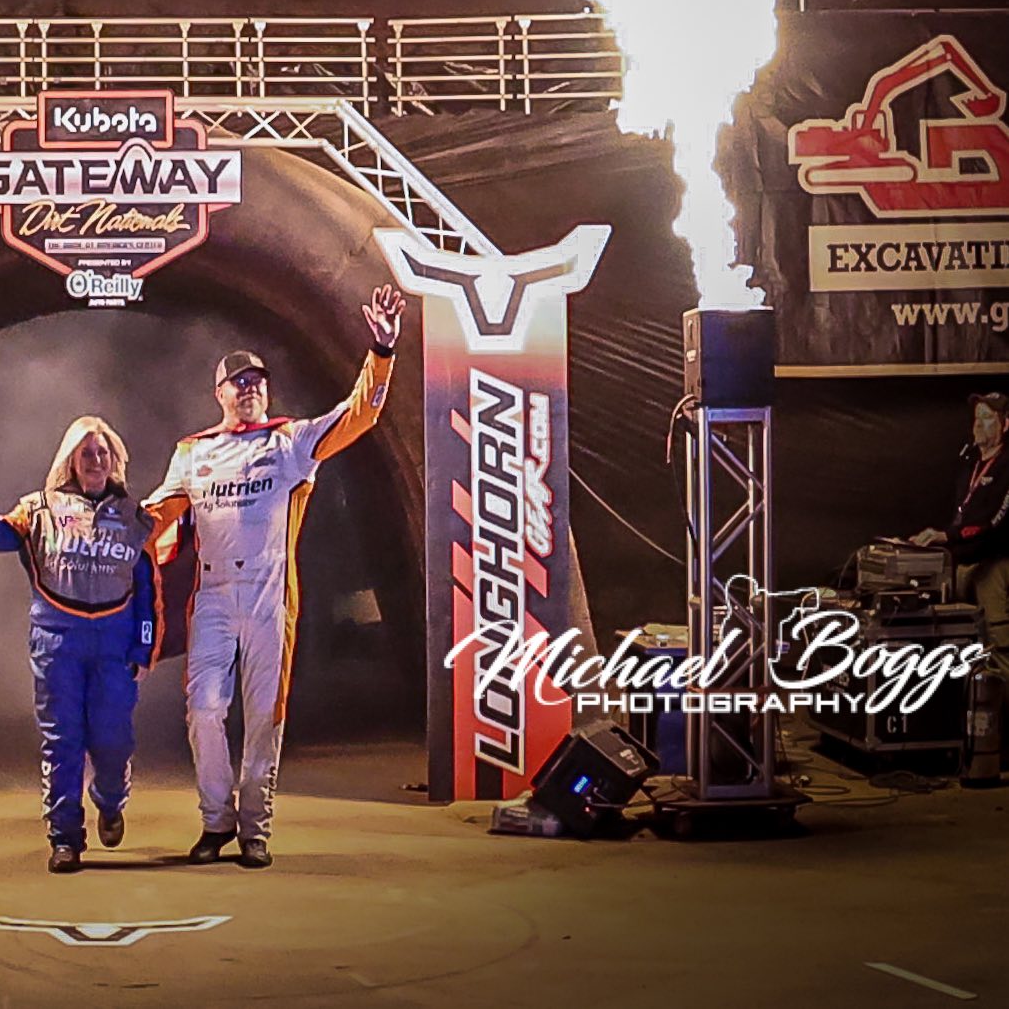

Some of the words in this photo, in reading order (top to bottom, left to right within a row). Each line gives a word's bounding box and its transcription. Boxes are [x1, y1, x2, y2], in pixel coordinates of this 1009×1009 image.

[53, 106, 157, 133] Kubota
[18, 199, 82, 236] Dirt
[79, 199, 191, 235] Nationals
[826, 240, 1009, 273] EXCAVATI
[470, 367, 525, 776] LONGHORN
